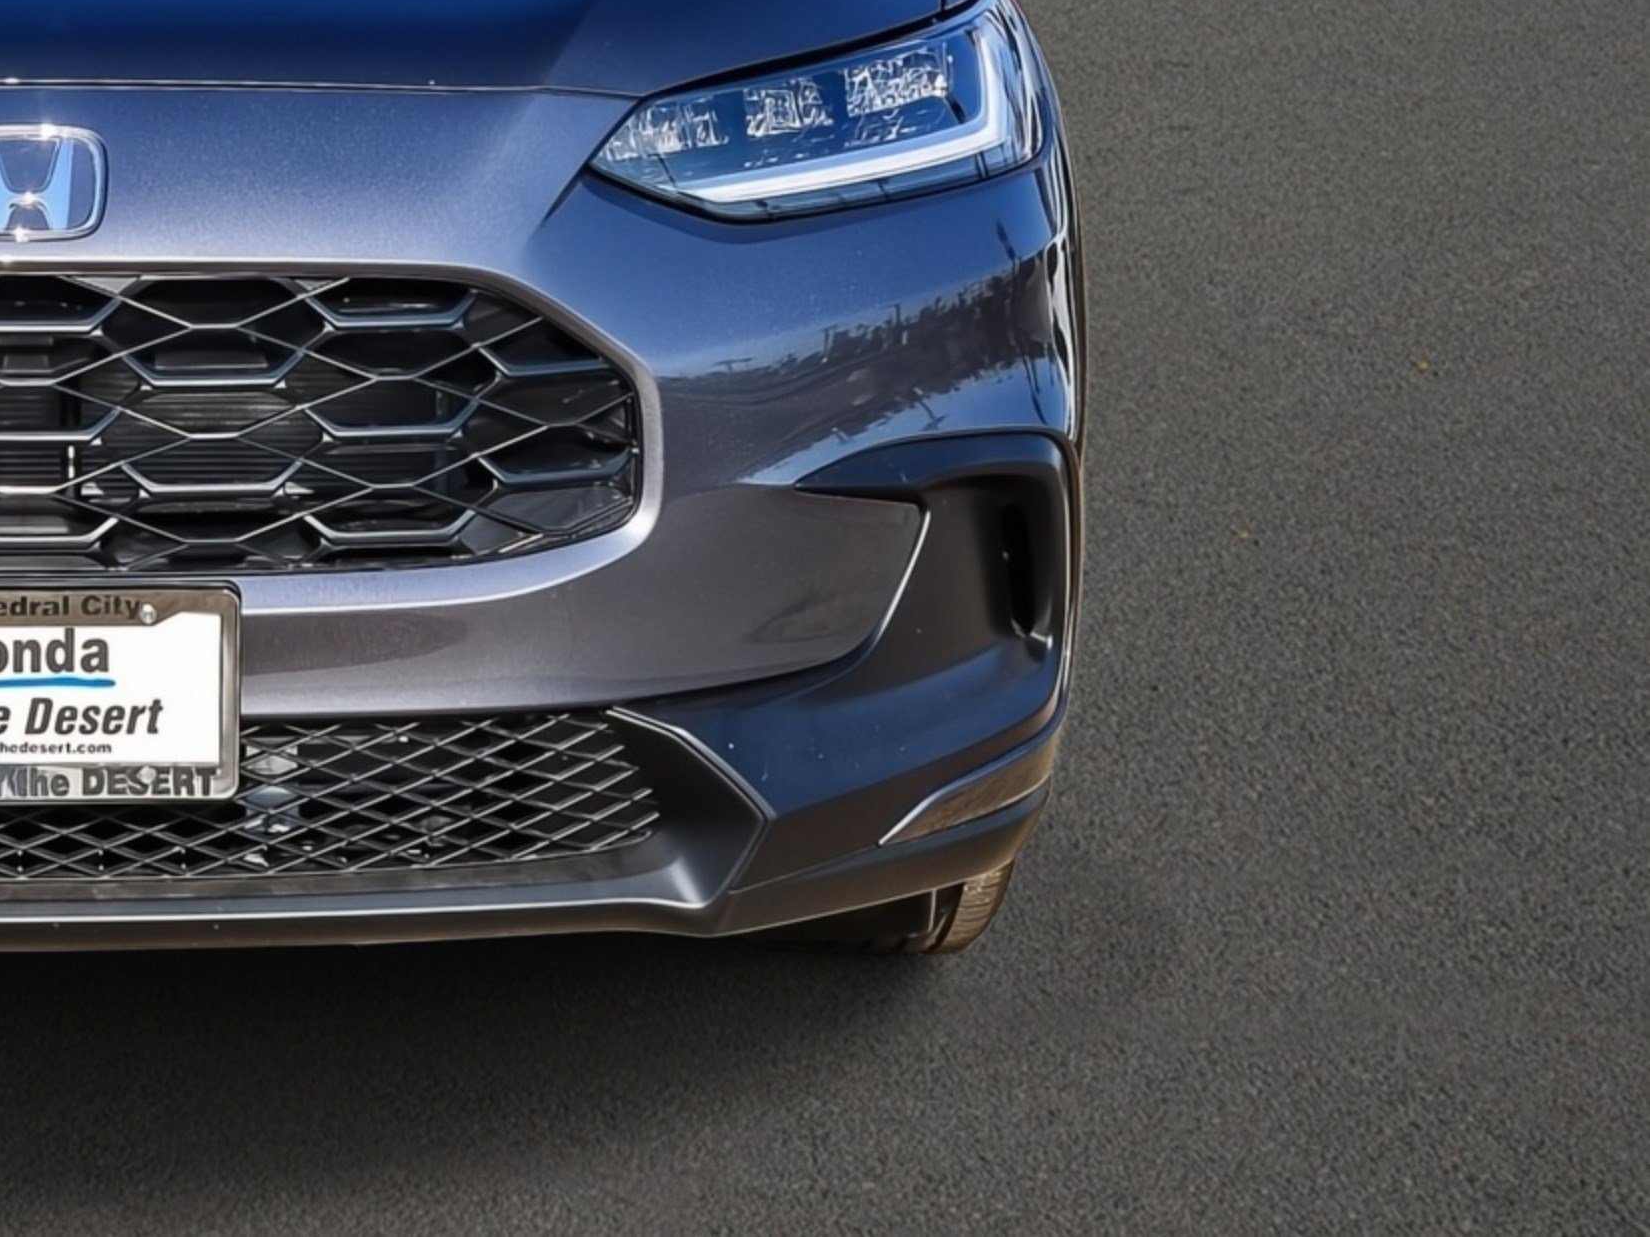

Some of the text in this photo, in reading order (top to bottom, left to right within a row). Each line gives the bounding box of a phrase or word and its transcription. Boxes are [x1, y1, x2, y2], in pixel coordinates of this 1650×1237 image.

[81, 594, 143, 620] City
[24, 697, 164, 735] Desert
[14, 765, 70, 797] the
[81, 765, 218, 796] DESERT
